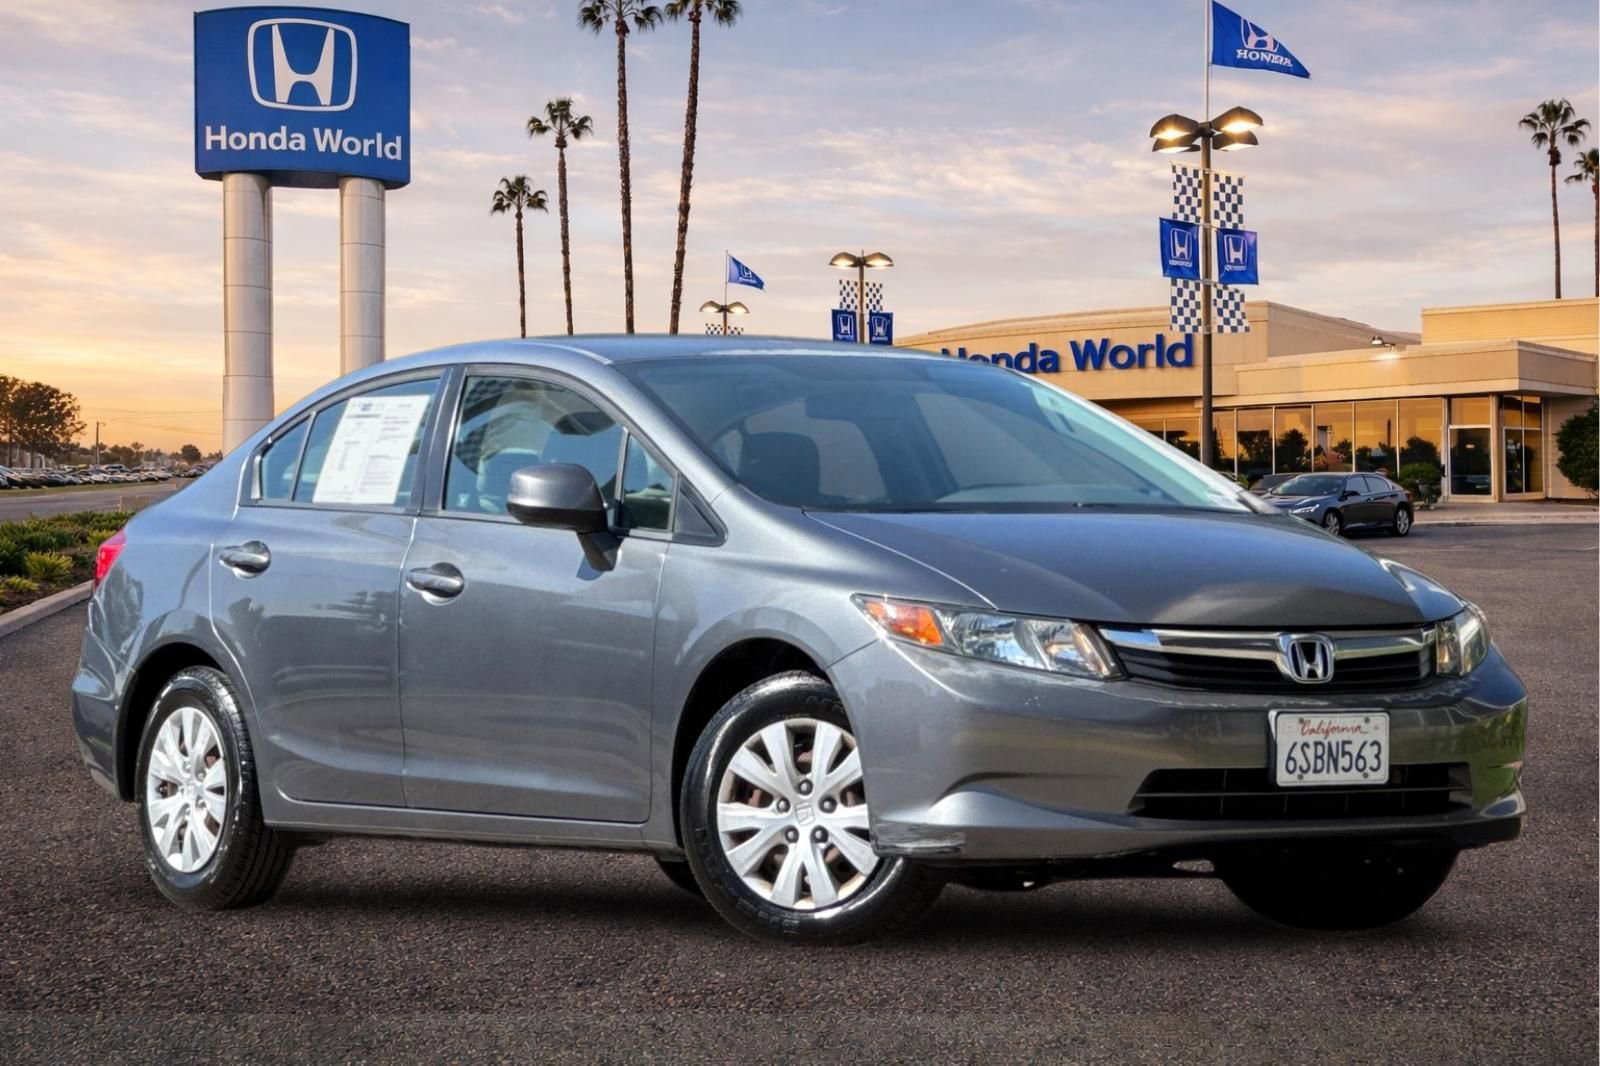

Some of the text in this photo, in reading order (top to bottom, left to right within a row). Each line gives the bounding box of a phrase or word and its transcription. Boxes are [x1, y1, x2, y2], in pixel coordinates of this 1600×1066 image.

[205, 125, 402, 161] Honda World
[1069, 332, 1195, 372] World
[1300, 719, 1368, 740] California
[1285, 740, 1382, 775] 6SBN563
